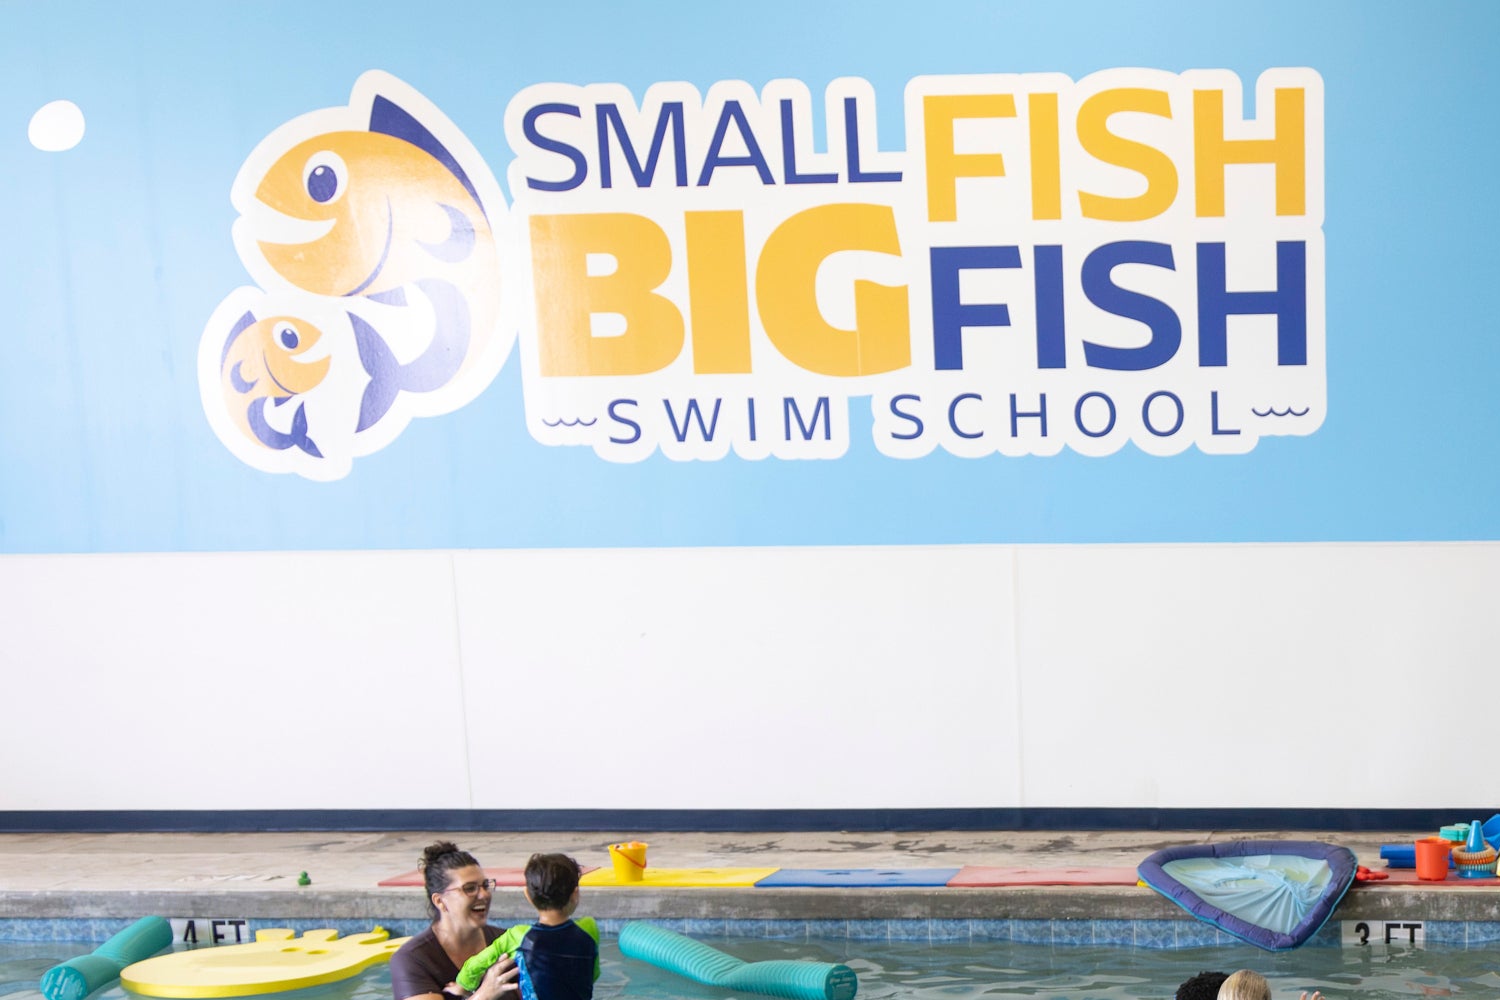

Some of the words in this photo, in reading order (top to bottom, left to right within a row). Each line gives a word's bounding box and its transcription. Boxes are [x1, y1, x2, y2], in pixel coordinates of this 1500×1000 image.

[523, 97, 903, 192] SMALL
[922, 87, 1306, 223] FISH
[528, 202, 912, 378] BIG
[930, 240, 1307, 371] FISH
[607, 397, 832, 445] SWIM
[890, 391, 1240, 440] SCHOOL
[212, 920, 246, 943] FT
[1385, 923, 1422, 944] FT
